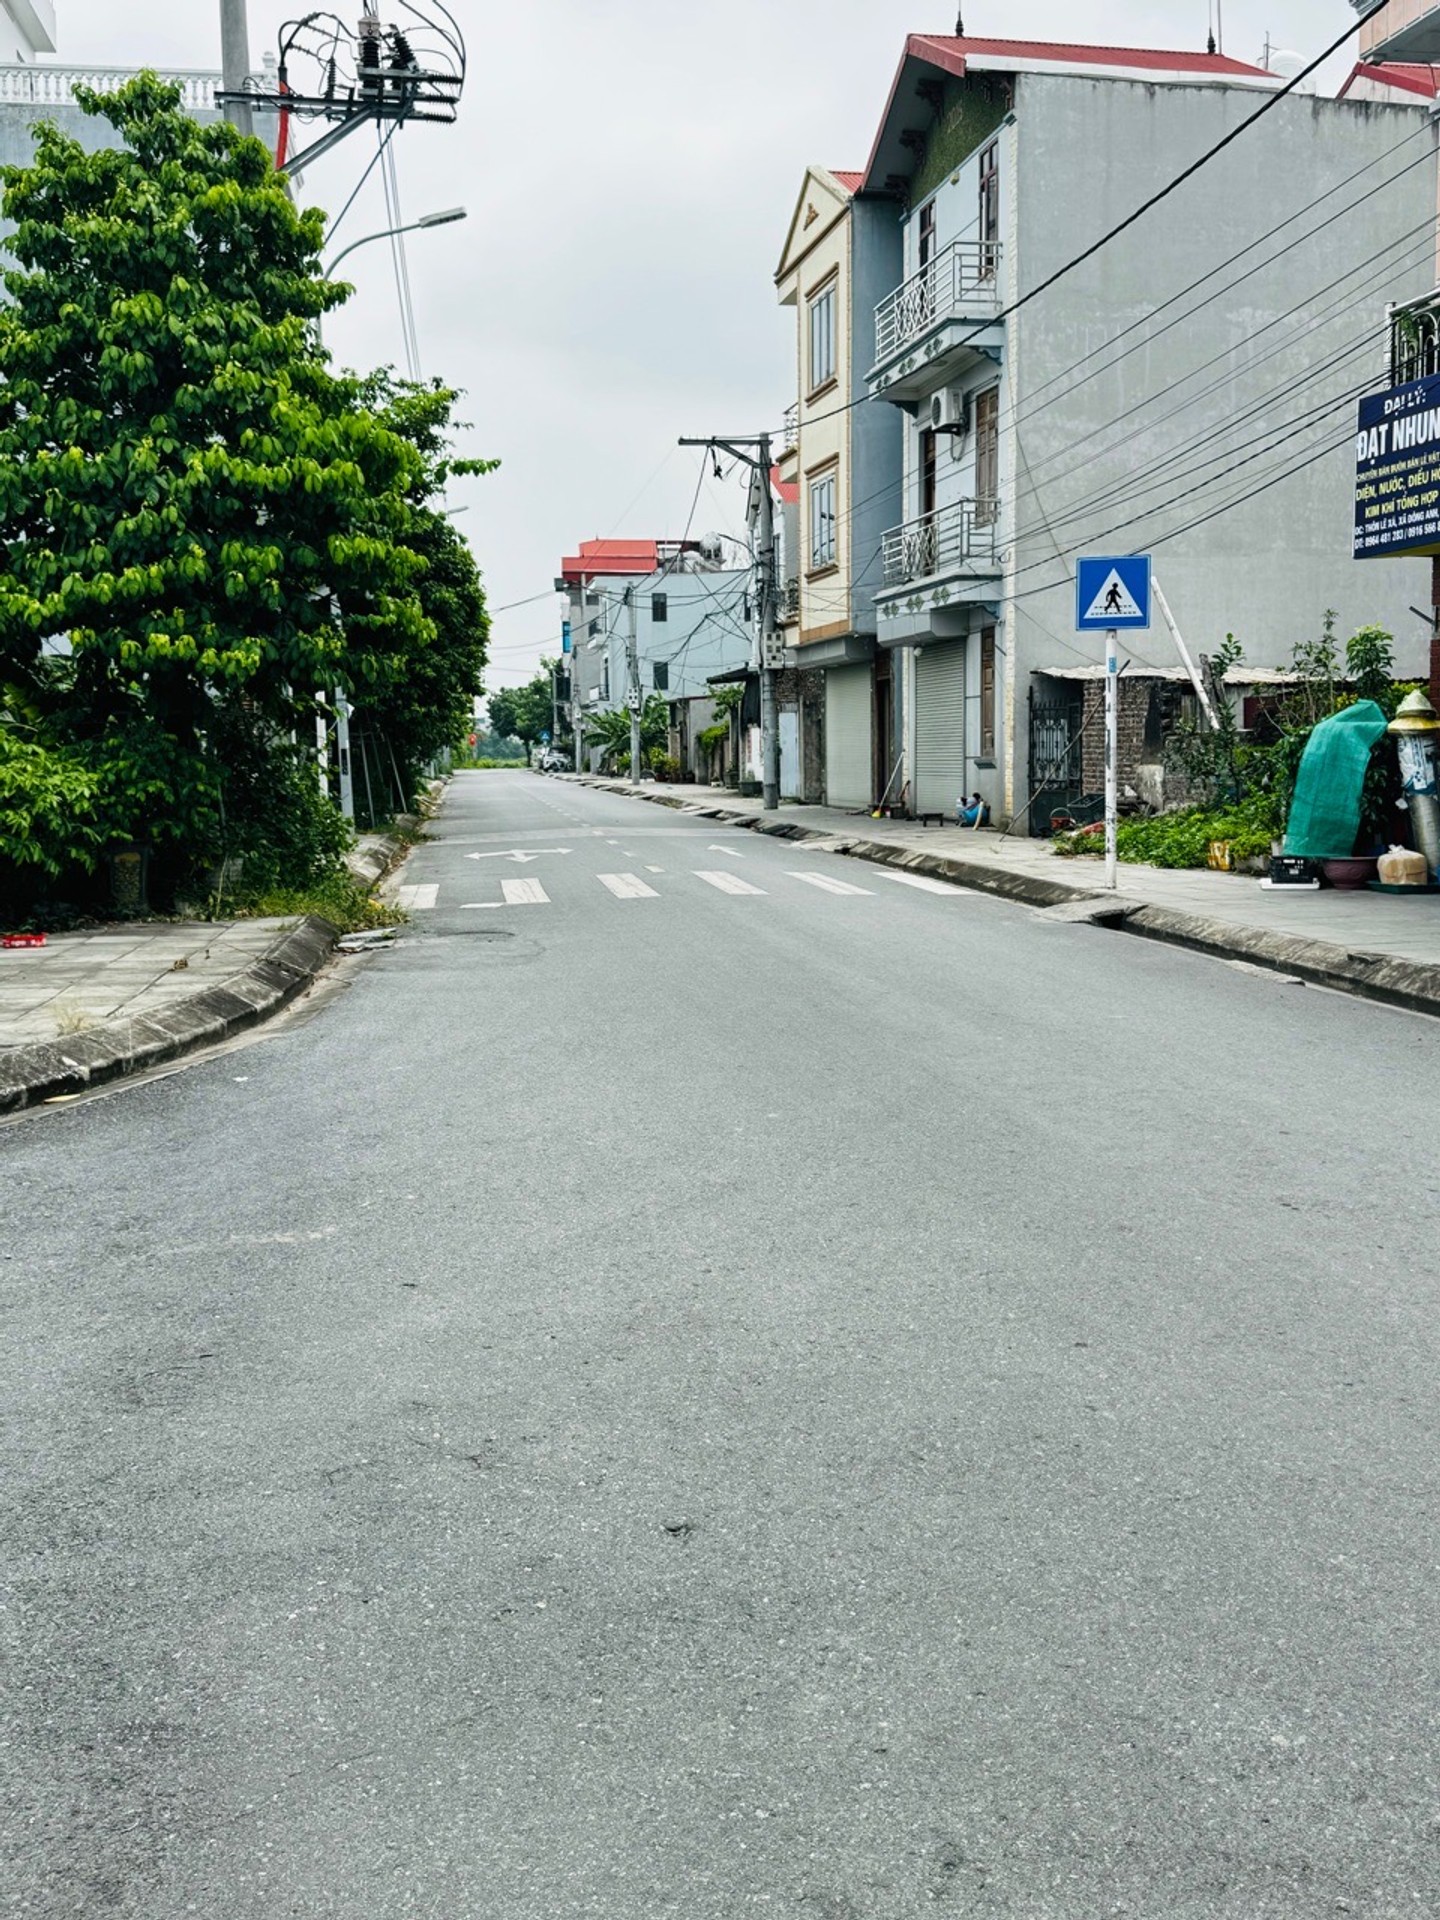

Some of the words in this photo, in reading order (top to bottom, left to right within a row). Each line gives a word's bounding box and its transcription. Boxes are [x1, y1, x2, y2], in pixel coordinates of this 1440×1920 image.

[1356, 423, 1389, 465] ĐẠT
[1365, 504, 1380, 519] KIM
[1381, 497, 1395, 514] KHÍ
